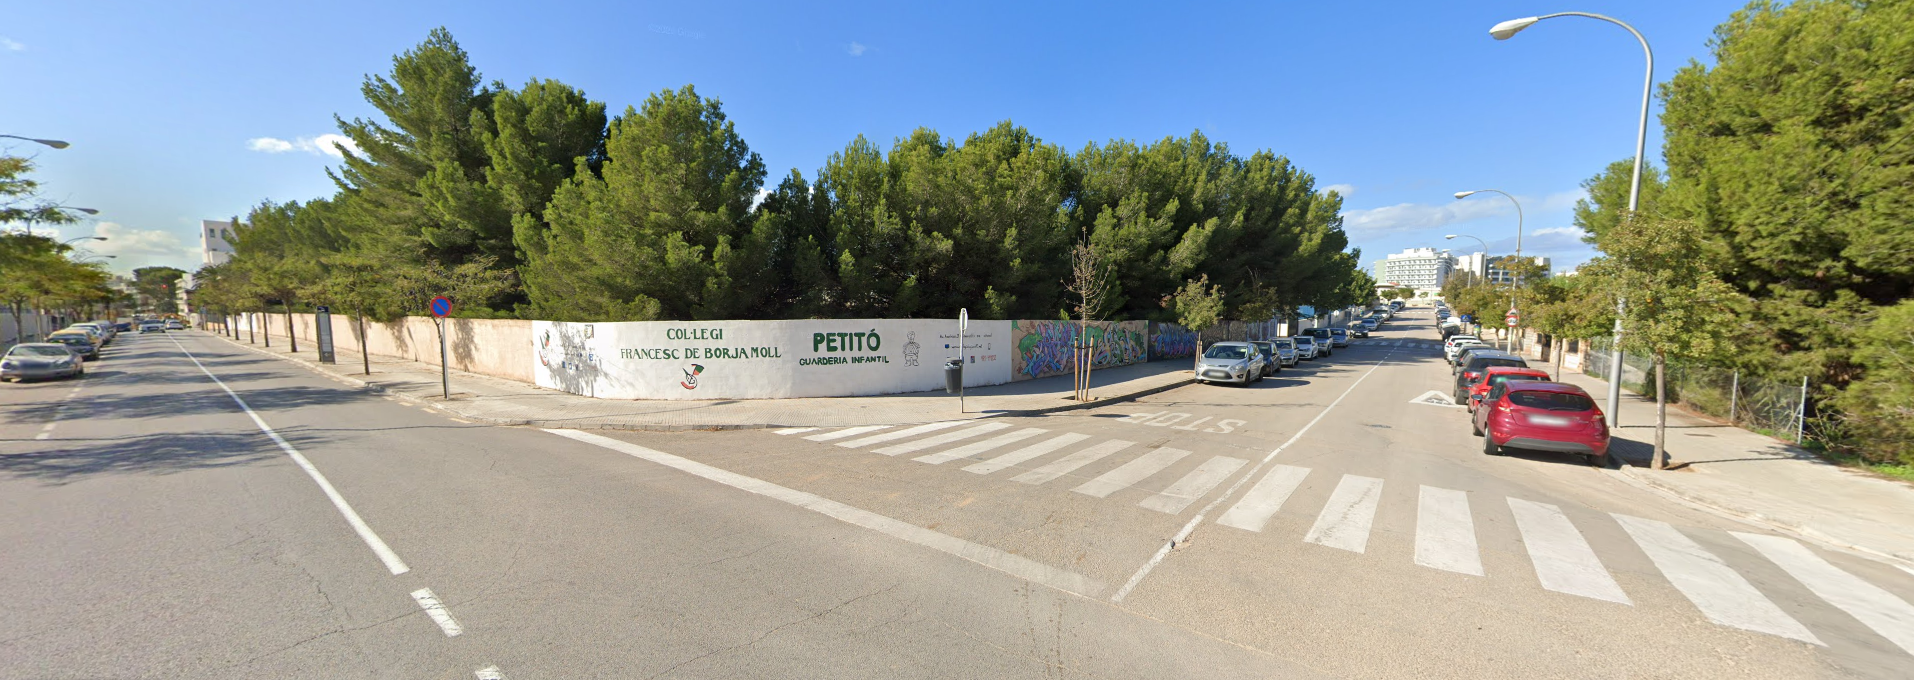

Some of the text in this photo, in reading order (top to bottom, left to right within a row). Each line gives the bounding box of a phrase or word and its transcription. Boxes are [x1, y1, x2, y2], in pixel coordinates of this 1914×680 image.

[667, 328, 723, 340] COL·LEGI
[813, 328, 881, 352] PETITÓ
[620, 346, 781, 359] FRANCESC DE BORJA MOLL
[799, 355, 889, 366] GUARDERIA INFANTIL
[1116, 411, 1248, 433] STOP
